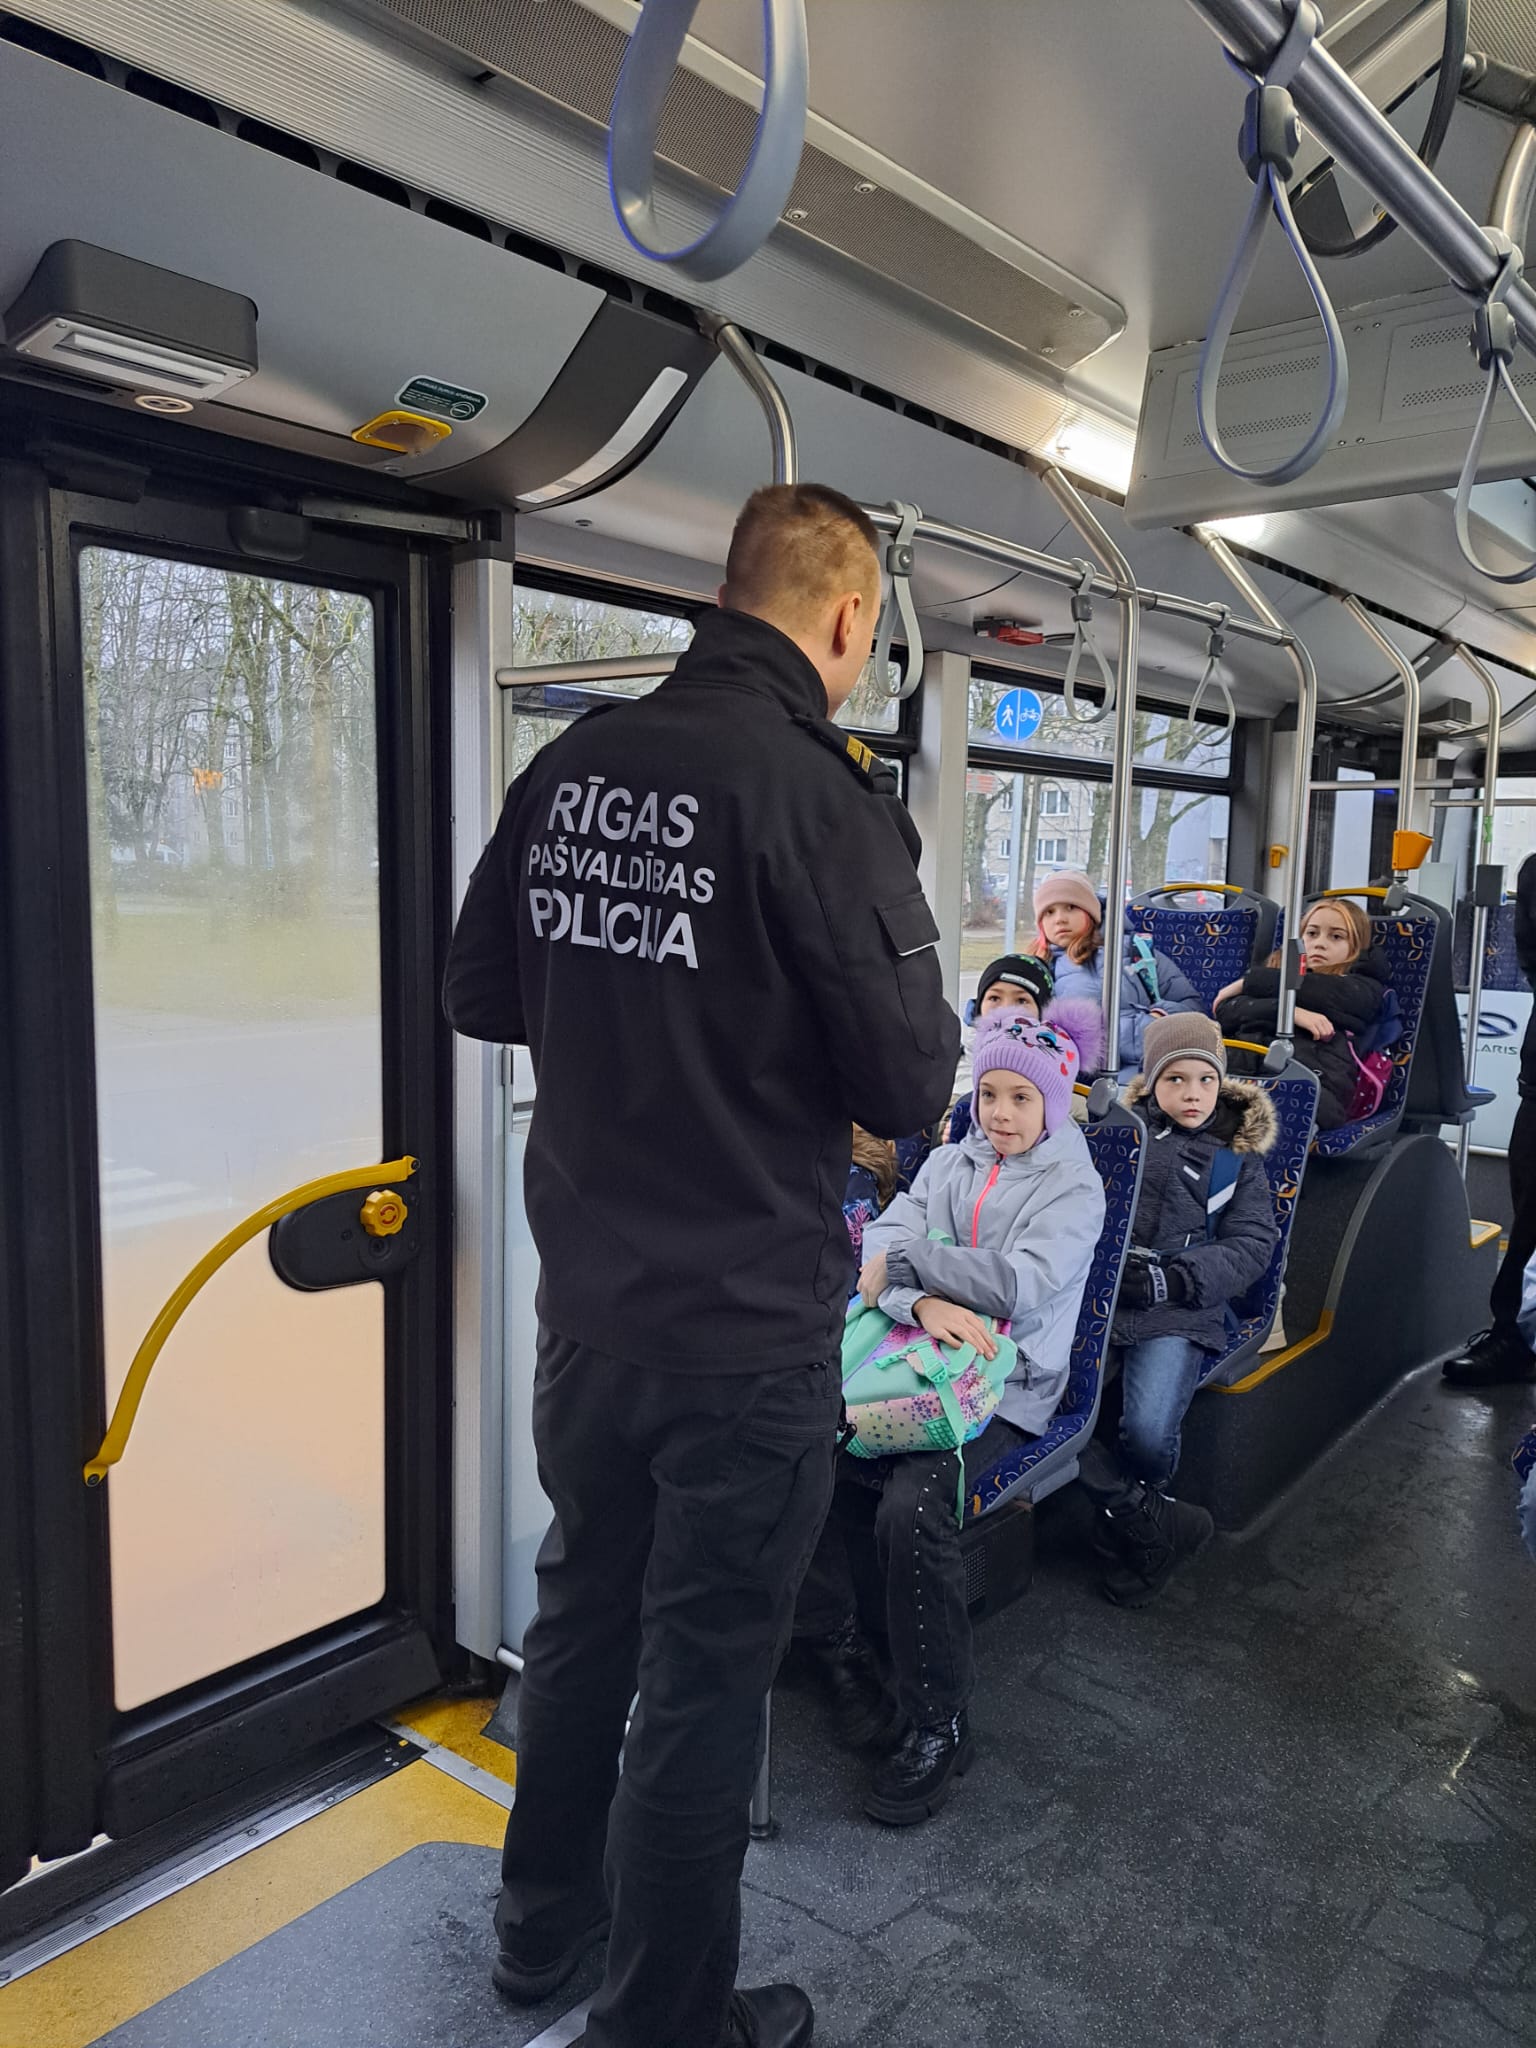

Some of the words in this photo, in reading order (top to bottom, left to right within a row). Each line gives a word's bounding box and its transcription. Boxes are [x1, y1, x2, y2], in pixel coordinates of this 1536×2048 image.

[548, 776, 699, 848] RĪGAS
[528, 836, 716, 904] PAŠVALDĪBAS
[529, 888, 699, 969] POLICIJA
